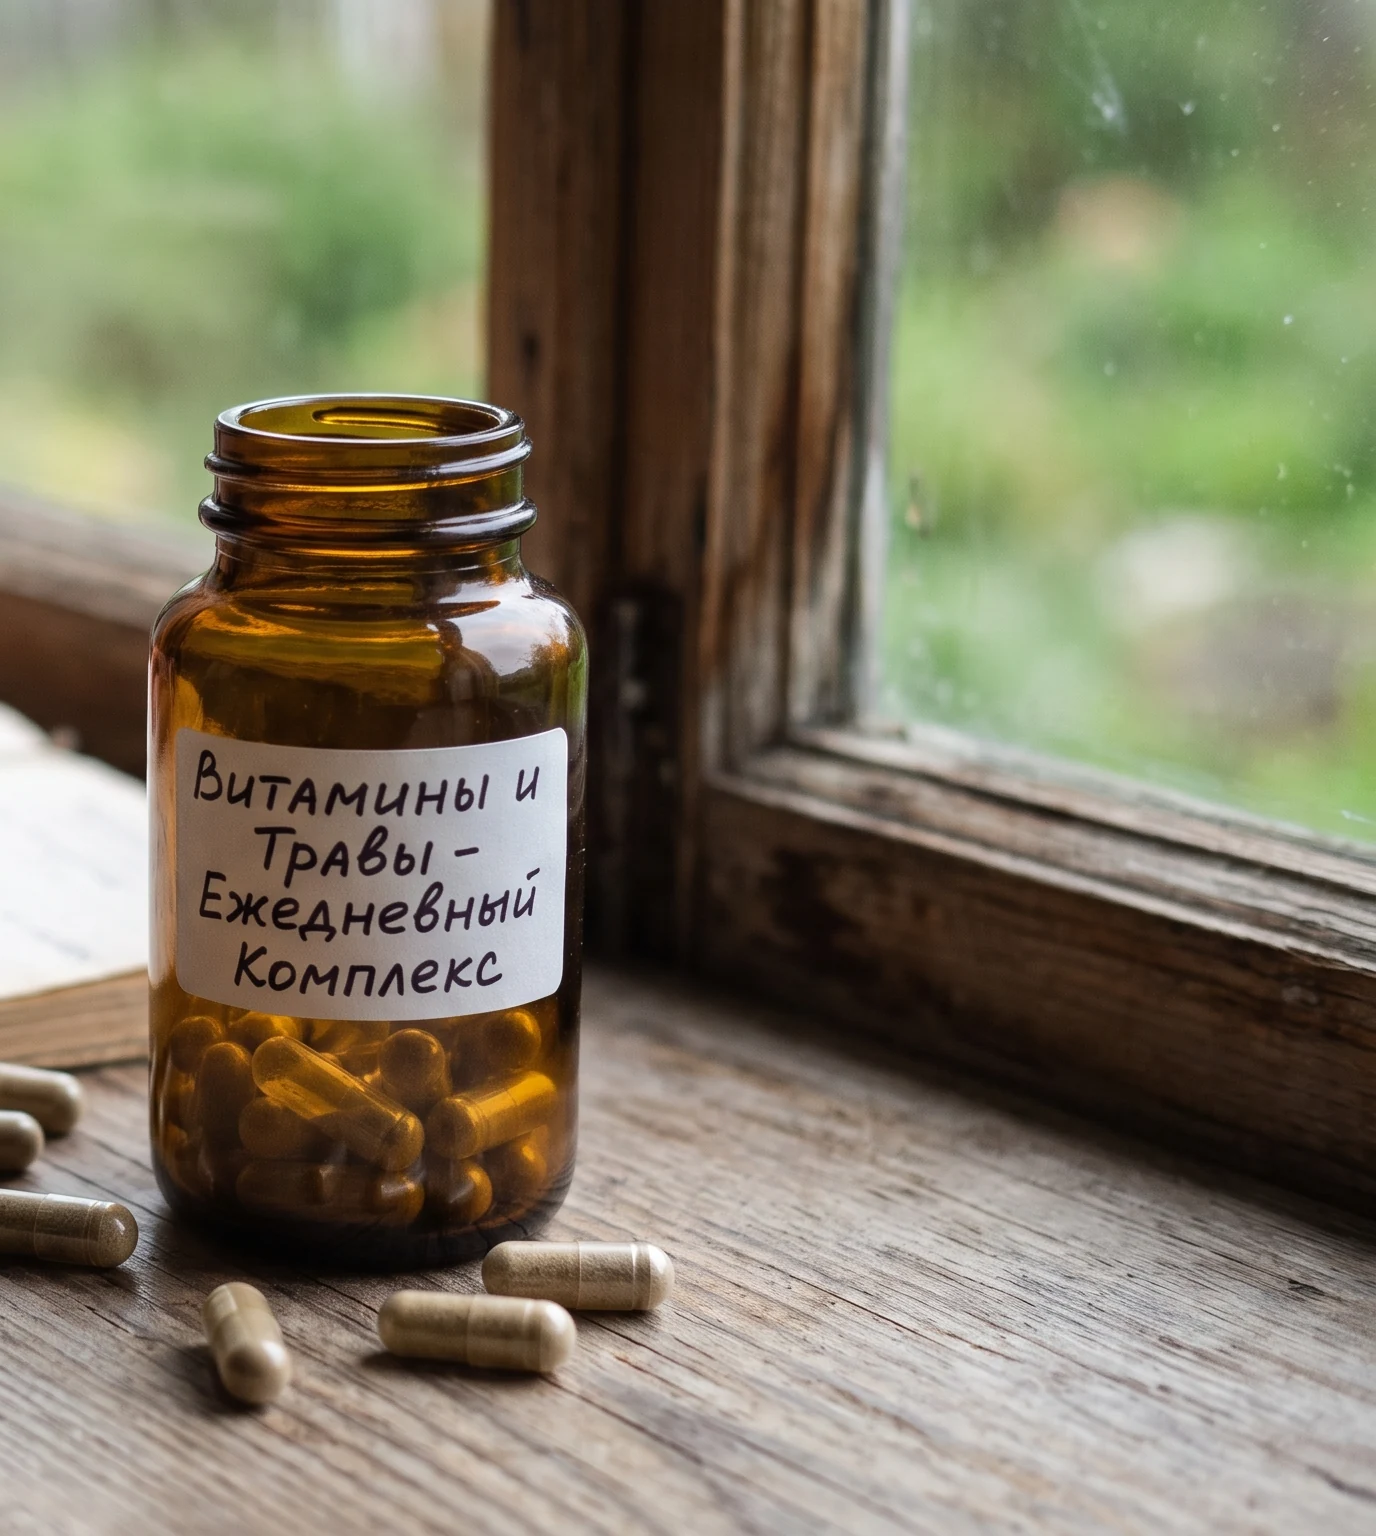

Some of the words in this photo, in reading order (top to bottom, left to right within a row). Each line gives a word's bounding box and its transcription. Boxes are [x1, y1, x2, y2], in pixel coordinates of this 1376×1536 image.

[193, 748, 490, 817] Витамины
[515, 766, 541, 802] и
[254, 825, 434, 889] Травы
[199, 868, 542, 943] Ежедневный
[233, 941, 504, 998] Комплекс
